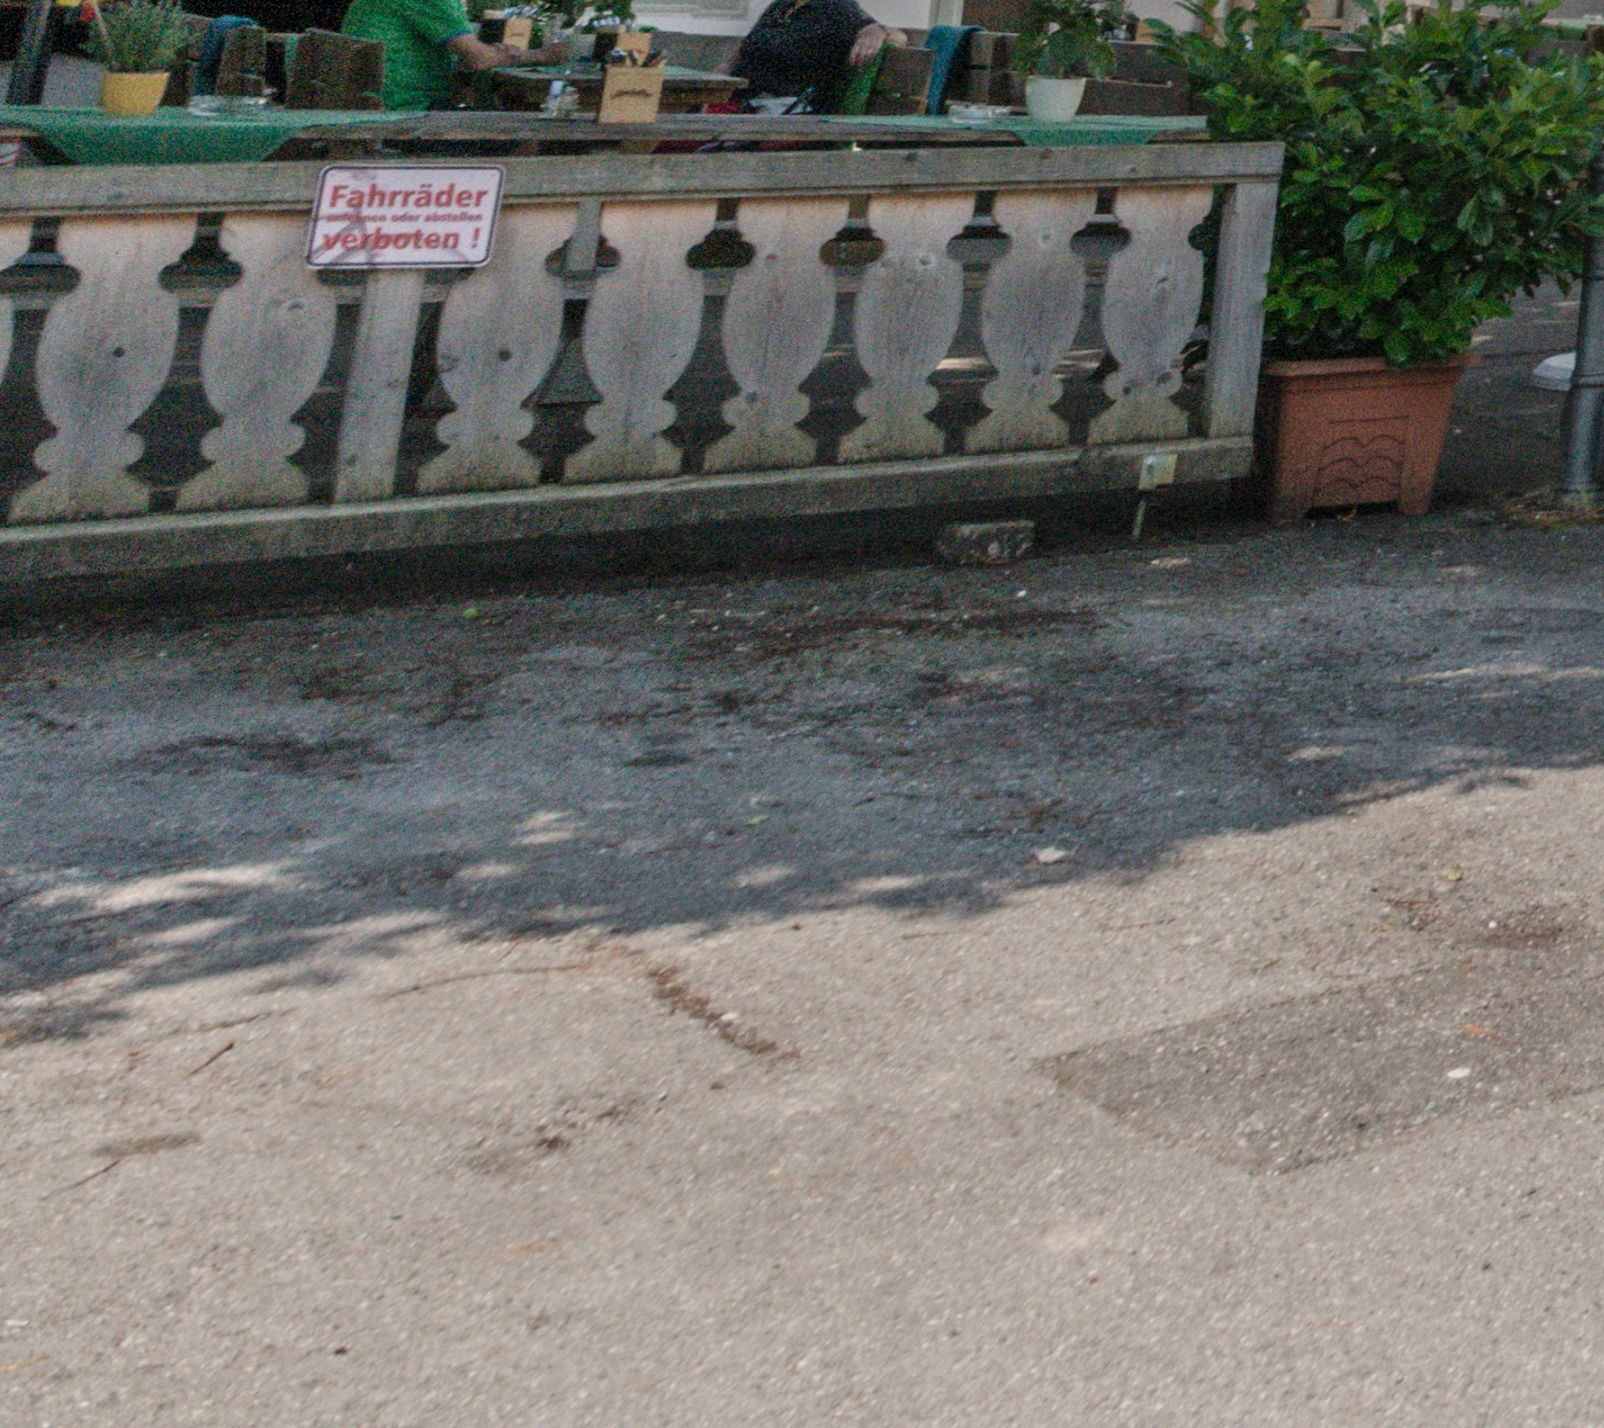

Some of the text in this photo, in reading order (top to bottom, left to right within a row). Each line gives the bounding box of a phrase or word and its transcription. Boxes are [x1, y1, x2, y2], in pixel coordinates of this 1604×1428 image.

[329, 183, 489, 208] Fahrräder
[390, 211, 420, 223] oder
[424, 211, 483, 223] abstellen
[322, 227, 481, 250] verboten !
